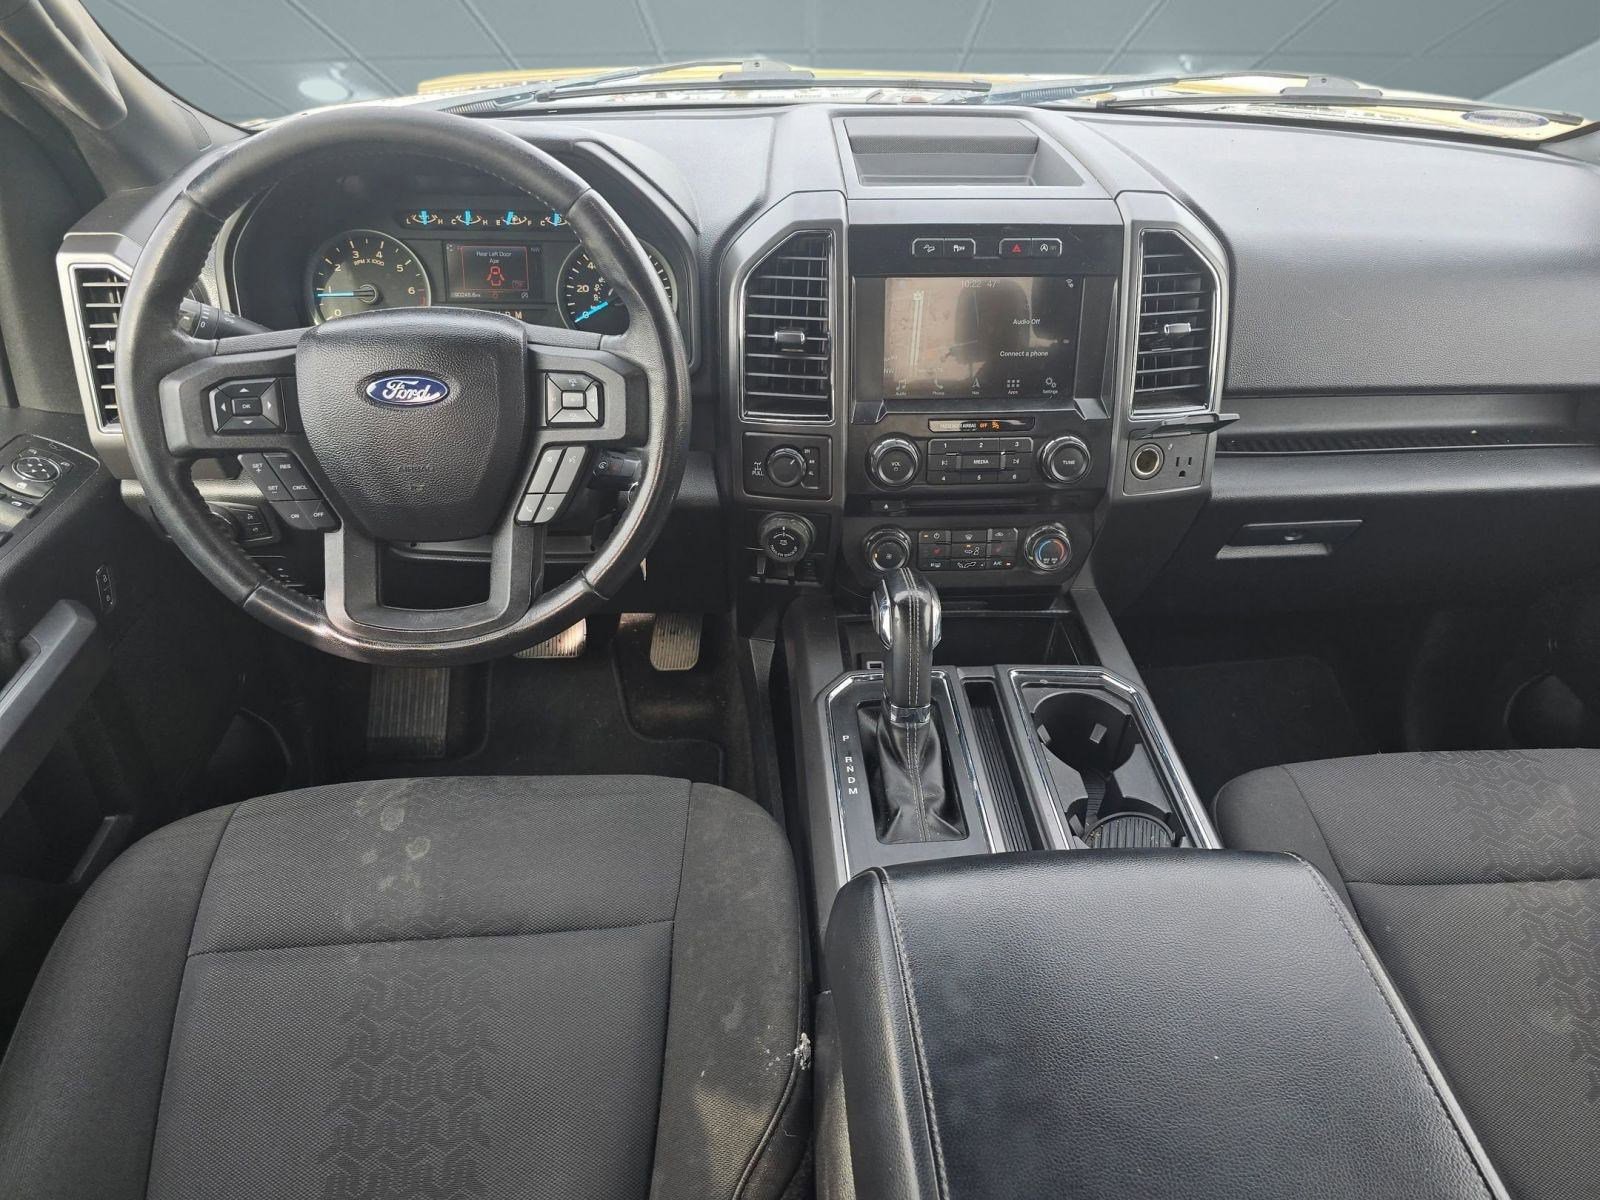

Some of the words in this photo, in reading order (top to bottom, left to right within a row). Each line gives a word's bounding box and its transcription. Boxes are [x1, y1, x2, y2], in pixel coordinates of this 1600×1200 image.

[335, 264, 341, 272] 2
[396, 264, 403, 272] 5
[576, 284, 590, 293] 20
[335, 309, 341, 317] 0
[514, 311, 523, 319] M
[1030, 350, 1049, 358] phone
[382, 379, 441, 401] Ford
[847, 776, 856, 784] D
[848, 787, 858, 795] M
